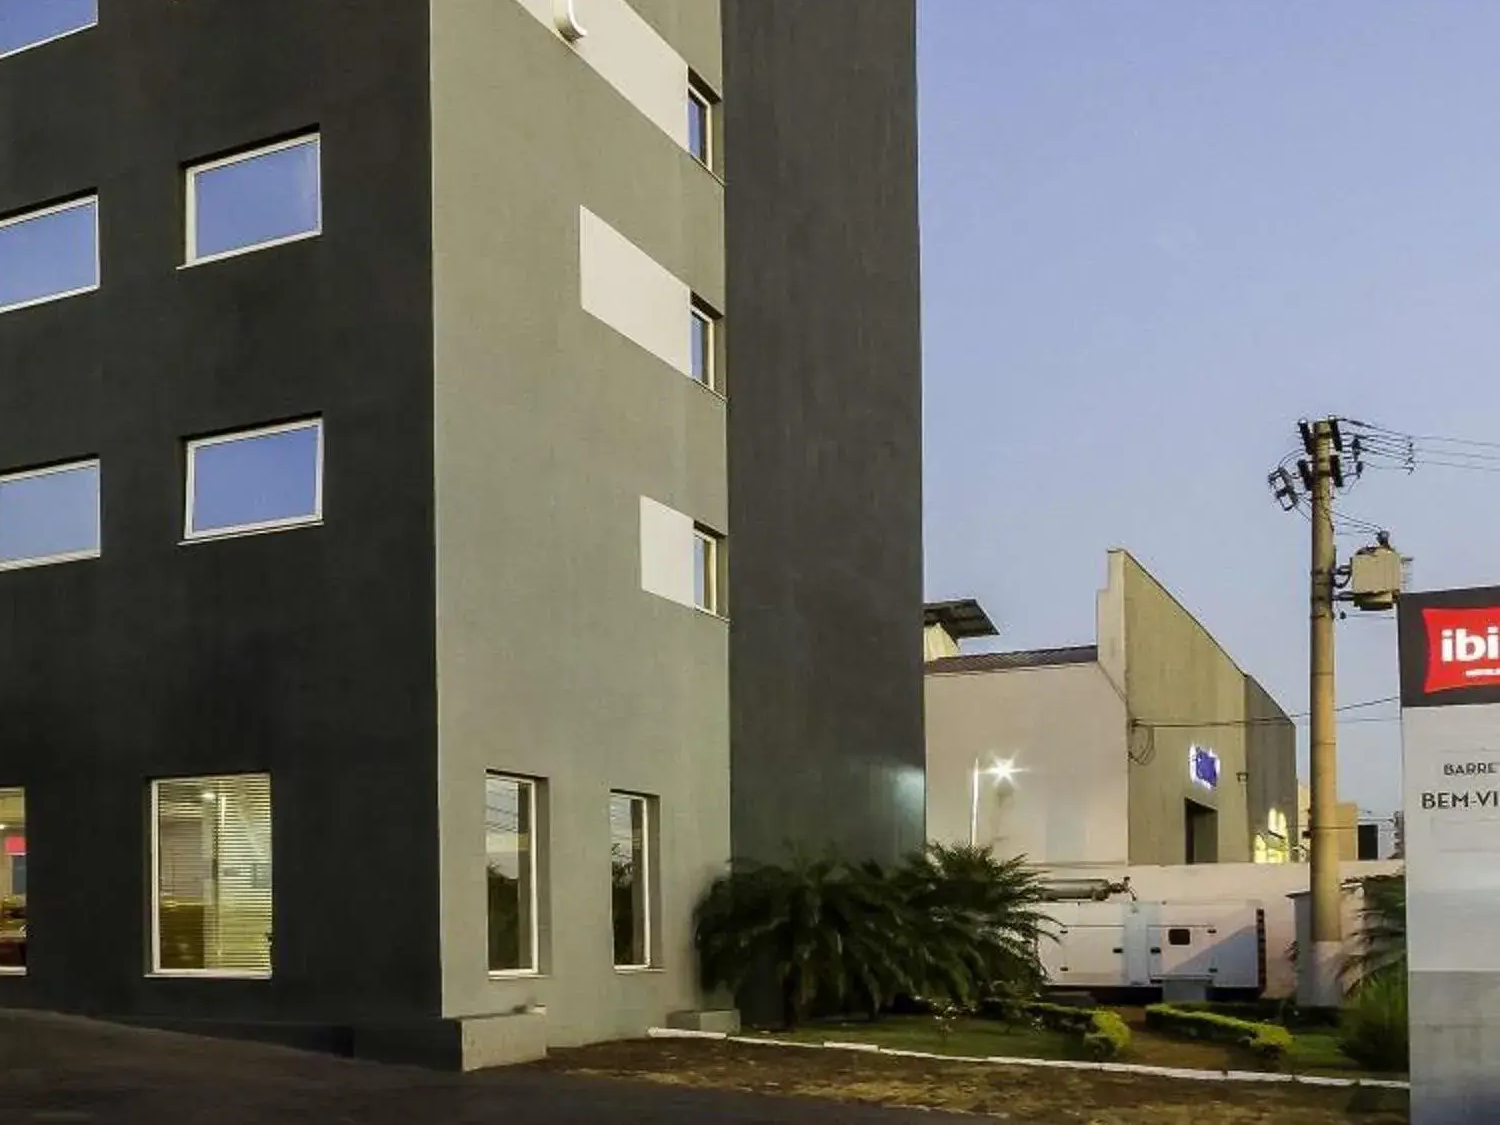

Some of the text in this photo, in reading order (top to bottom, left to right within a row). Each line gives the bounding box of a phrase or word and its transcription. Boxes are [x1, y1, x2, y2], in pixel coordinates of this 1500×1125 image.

[1442, 626, 1499, 662] ibi
[1444, 762, 1500, 776] BARRE
[1422, 790, 1498, 809] BEM-VI
